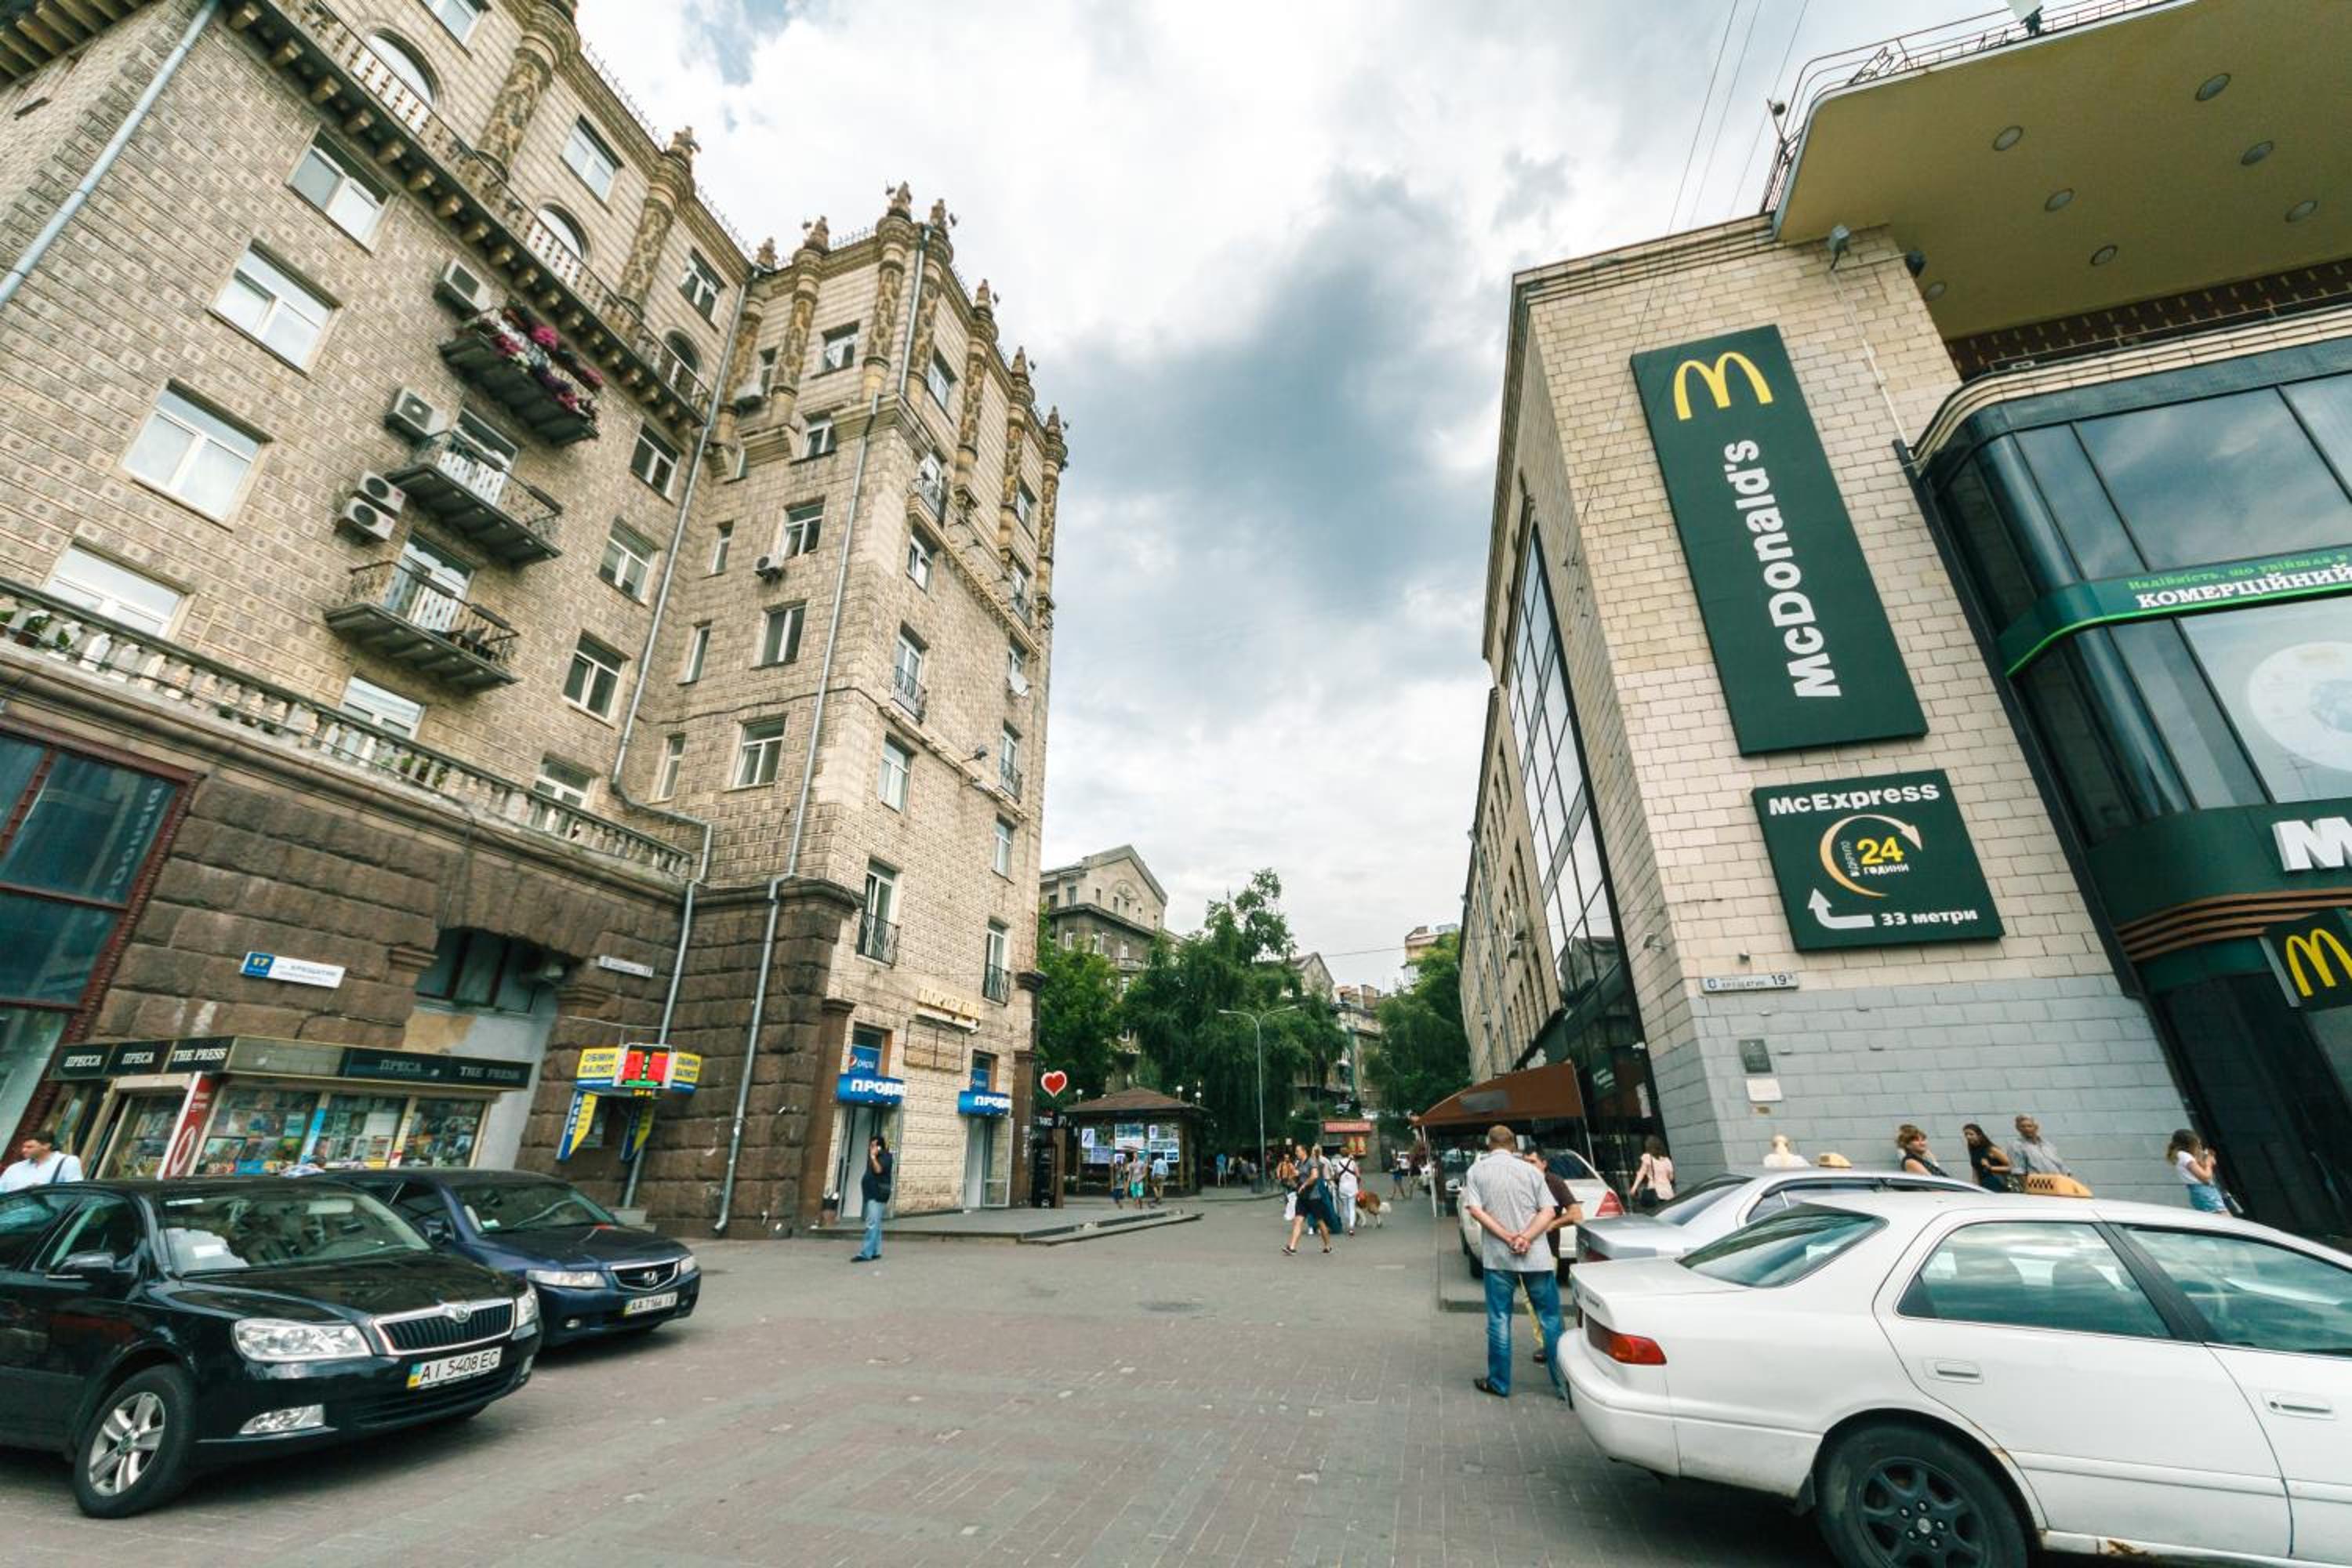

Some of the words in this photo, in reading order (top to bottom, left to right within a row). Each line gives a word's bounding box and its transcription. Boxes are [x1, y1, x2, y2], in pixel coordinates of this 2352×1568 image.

[1724, 439, 1842, 698] McDonald's
[2136, 563, 2352, 610] КОМЕРЦІЙНИЙ
[1769, 783, 1940, 816] McExpress
[1857, 836, 1904, 866] 24
[1863, 863, 1910, 876] години
[1882, 912, 1907, 927] 33
[1911, 909, 1979, 926] метри
[252, 956, 270, 967] 17
[172, 1049, 194, 1062] THE
[194, 1047, 227, 1061] PRESS
[459, 1065, 484, 1078] THE
[446, 1356, 479, 1377] 5408
[480, 1350, 499, 1369] EC
